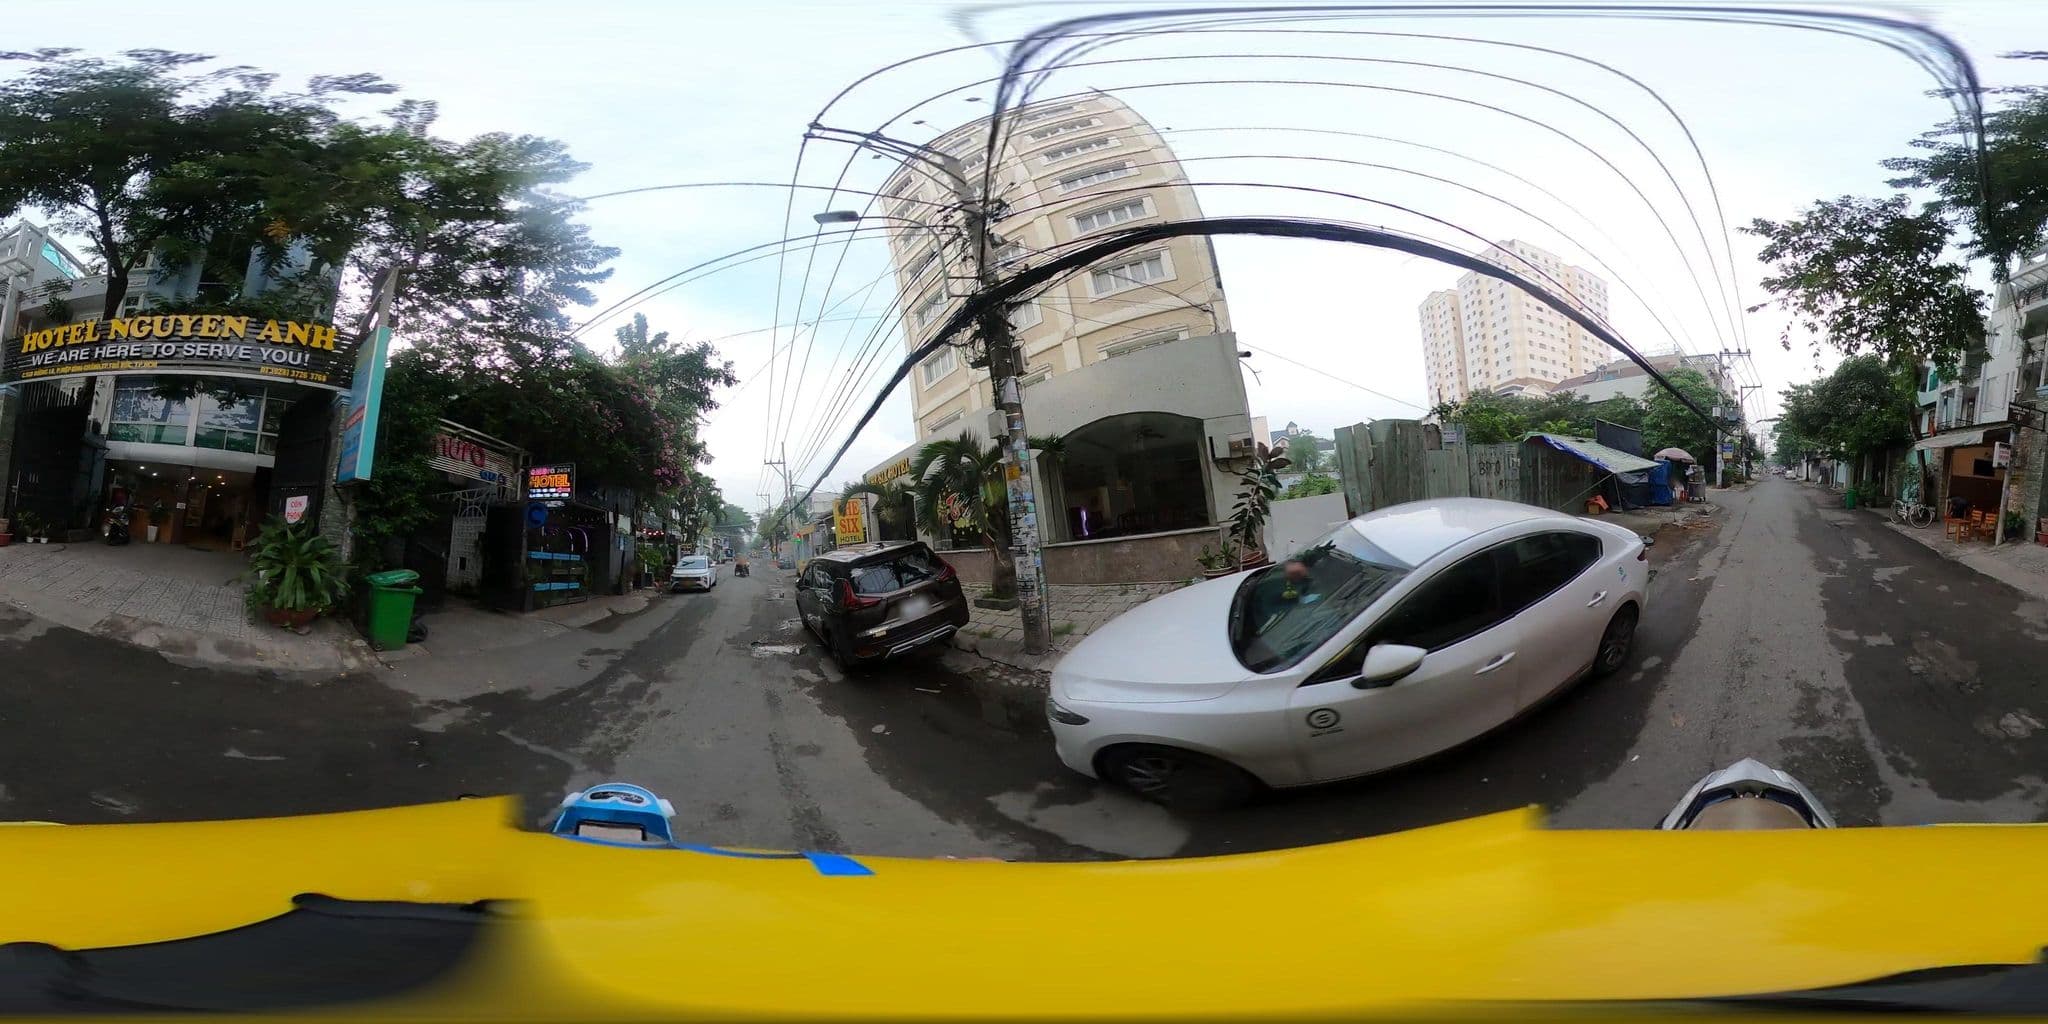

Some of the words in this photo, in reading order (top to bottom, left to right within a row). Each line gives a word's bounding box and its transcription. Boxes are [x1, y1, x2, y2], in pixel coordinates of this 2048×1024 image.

[21, 320, 100, 353] HOTEL
[108, 314, 250, 341] NGUYEN
[255, 319, 337, 350] ANH
[31, 353, 54, 366] WE
[57, 347, 90, 363] ARE
[94, 343, 142, 359] HERE
[151, 343, 176, 356] TO
[183, 343, 252, 359] SERVE
[260, 347, 311, 366] YOU!
[530, 474, 570, 487] HOTEL
[840, 518, 860, 534] SIX
[840, 535, 862, 543] HOTEL
